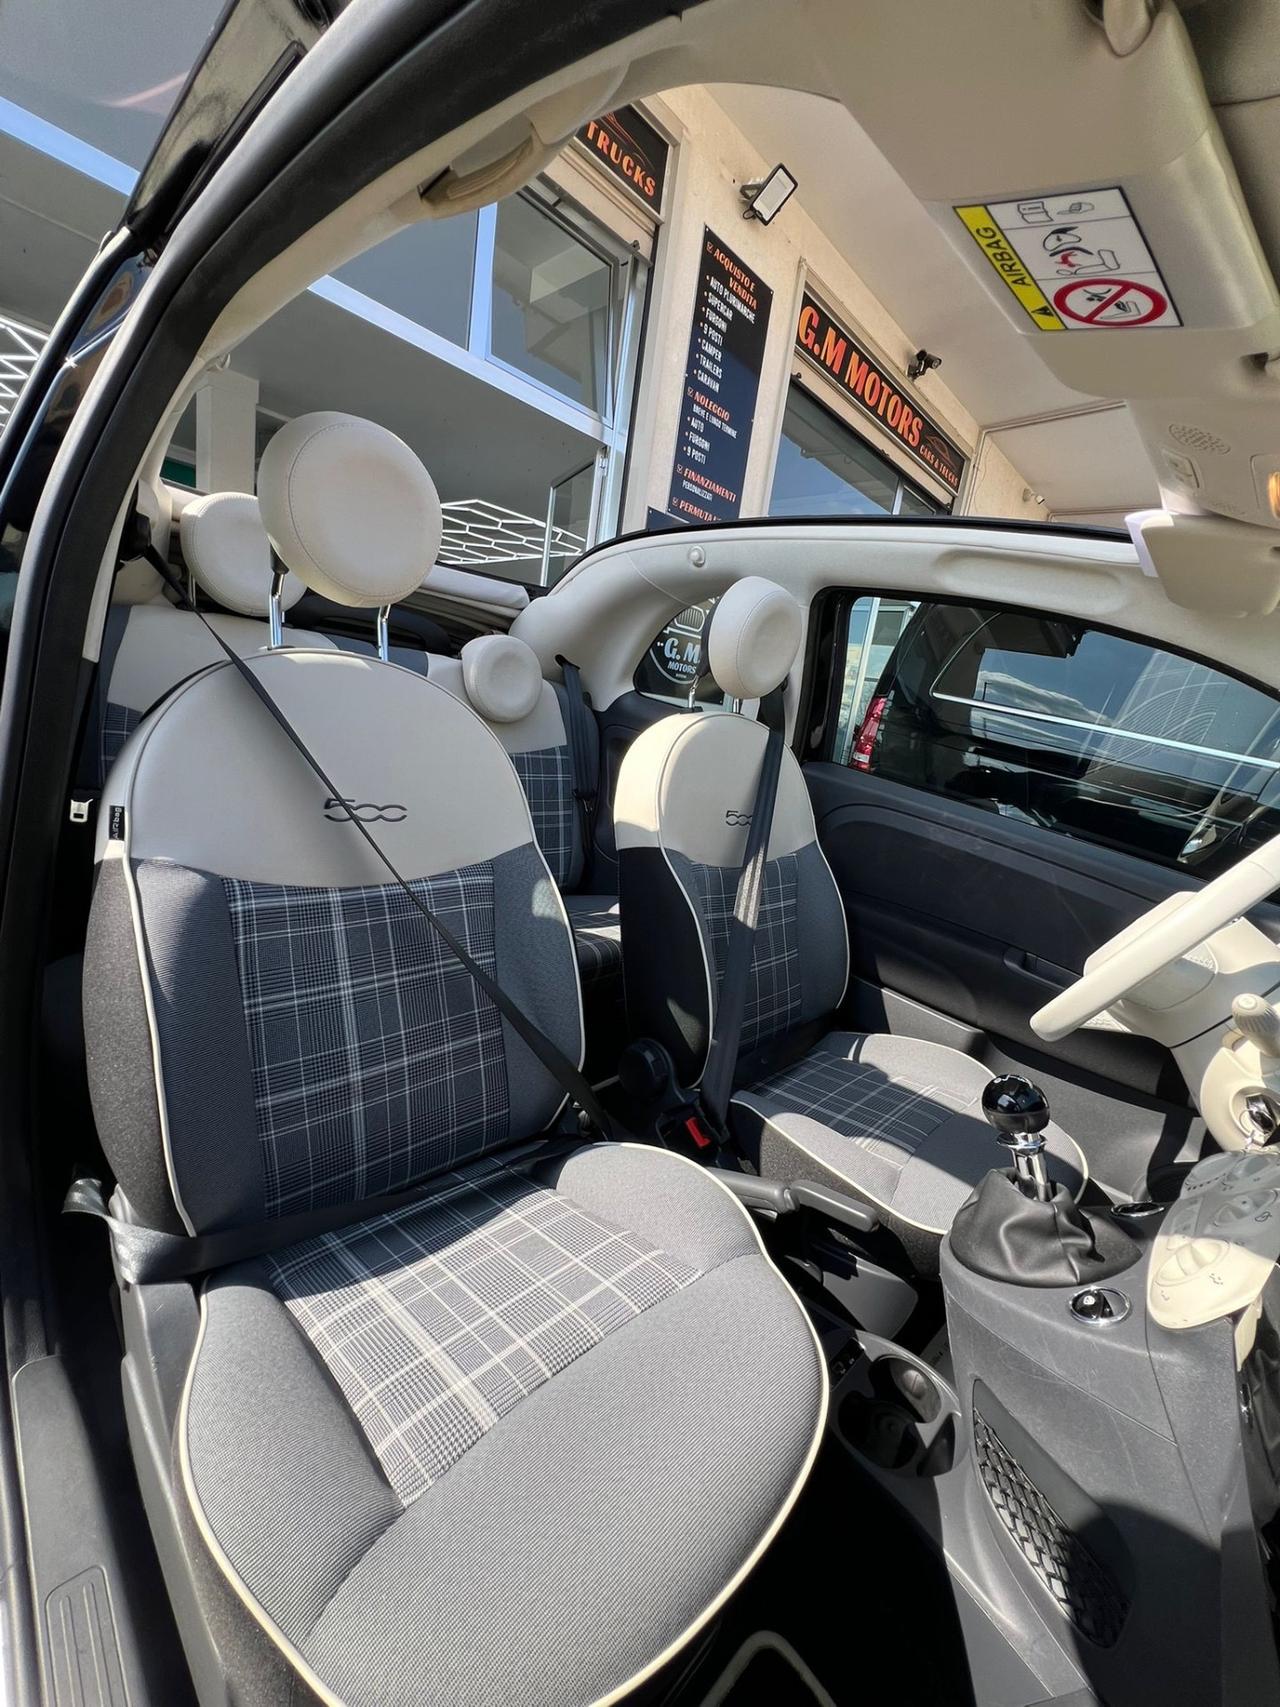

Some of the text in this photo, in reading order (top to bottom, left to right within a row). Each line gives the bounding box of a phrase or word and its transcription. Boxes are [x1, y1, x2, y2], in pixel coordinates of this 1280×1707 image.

[587, 121, 656, 197] TRUCKS
[975, 226, 1032, 287] AIRBAG
[714, 248, 756, 293] ACQUISTO E
[709, 276, 724, 296] AUTO
[729, 276, 758, 310] VENDITA
[708, 292, 734, 321] SUPERCAR
[705, 307, 728, 333] FURGONI
[708, 326, 723, 347] POSTI
[701, 338, 722, 362] CAMPER
[699, 353, 723, 379] TRAILERS
[697, 369, 720, 393] CARAVAN
[693, 391, 730, 422] NOLEGGIO
[844, 350, 924, 448] MOTORS
[690, 416, 705, 433] AUTO
[688, 431, 711, 452] FURGONI
[691, 448, 706, 465] POSTI
[919, 444, 936, 464] CARS
[938, 460, 959, 488] TRUCKS
[683, 467, 737, 503] FINANZIAMENTI
[679, 500, 712, 522] PERMUTA
[667, 660, 697, 675] MOTORS
[323, 798, 408, 823] 500
